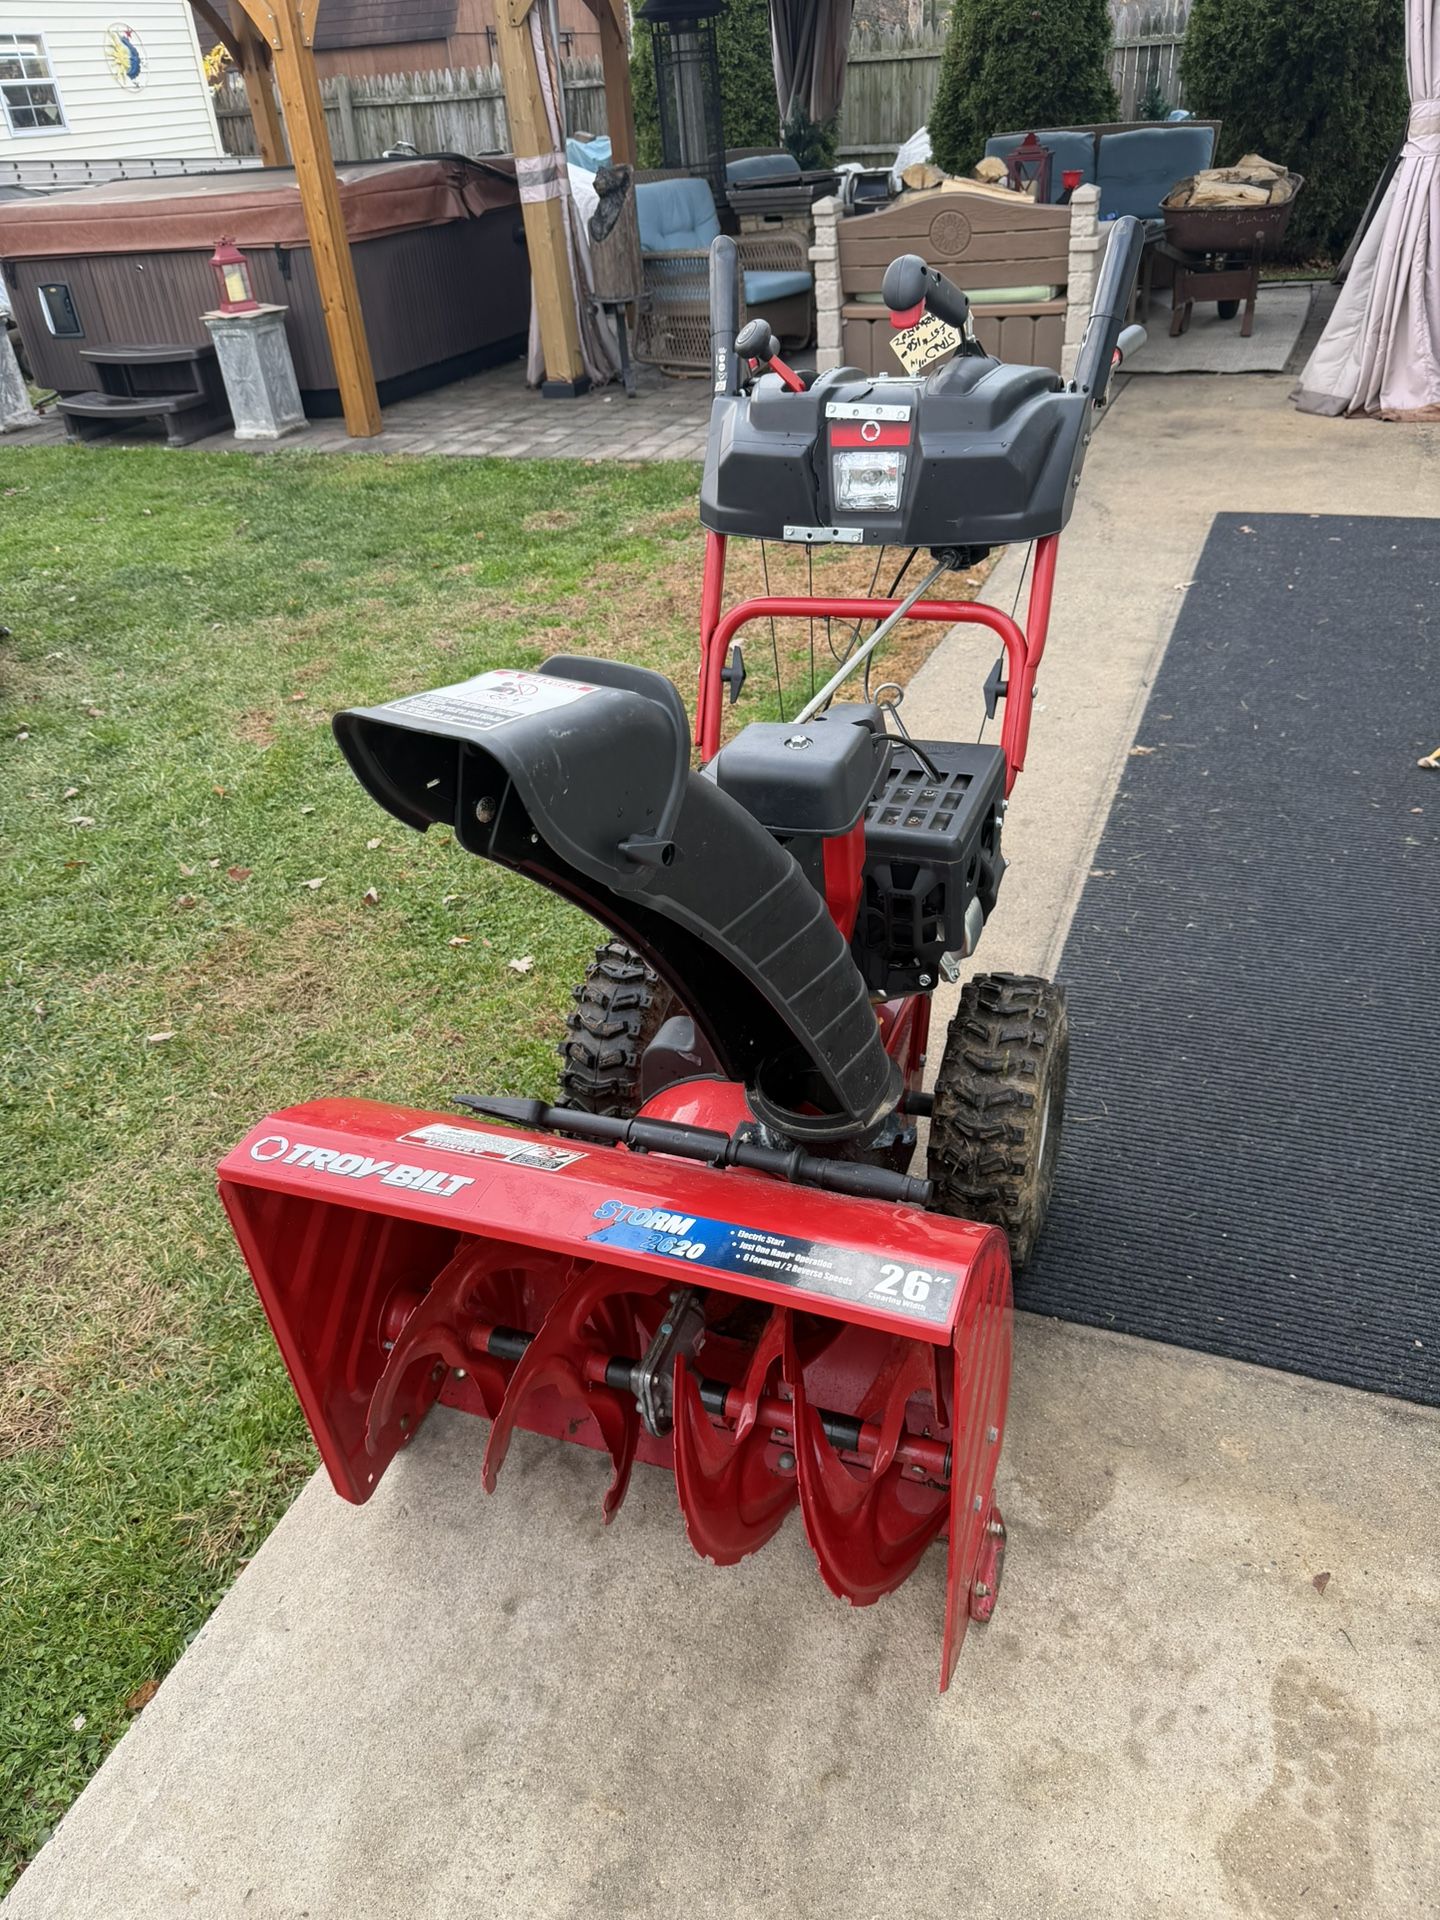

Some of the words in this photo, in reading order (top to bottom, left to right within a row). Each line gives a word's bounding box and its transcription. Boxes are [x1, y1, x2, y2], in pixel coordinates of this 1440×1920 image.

[281, 1143, 475, 1197] TROY-BILT
[592, 1199, 697, 1236] STORM
[639, 1233, 707, 1260] 2620
[737, 1229, 766, 1242] Electric
[767, 1237, 786, 1247] Start
[739, 1241, 754, 1251] Just
[755, 1244, 770, 1255] One
[795, 1254, 833, 1269] Operation
[749, 1255, 781, 1268] Forward
[785, 1263, 792, 1271] 2
[792, 1264, 823, 1279] Reverse
[824, 1271, 853, 1286] Speeds
[868, 1292, 902, 1306] Clearing
[902, 1299, 927, 1311] Width
